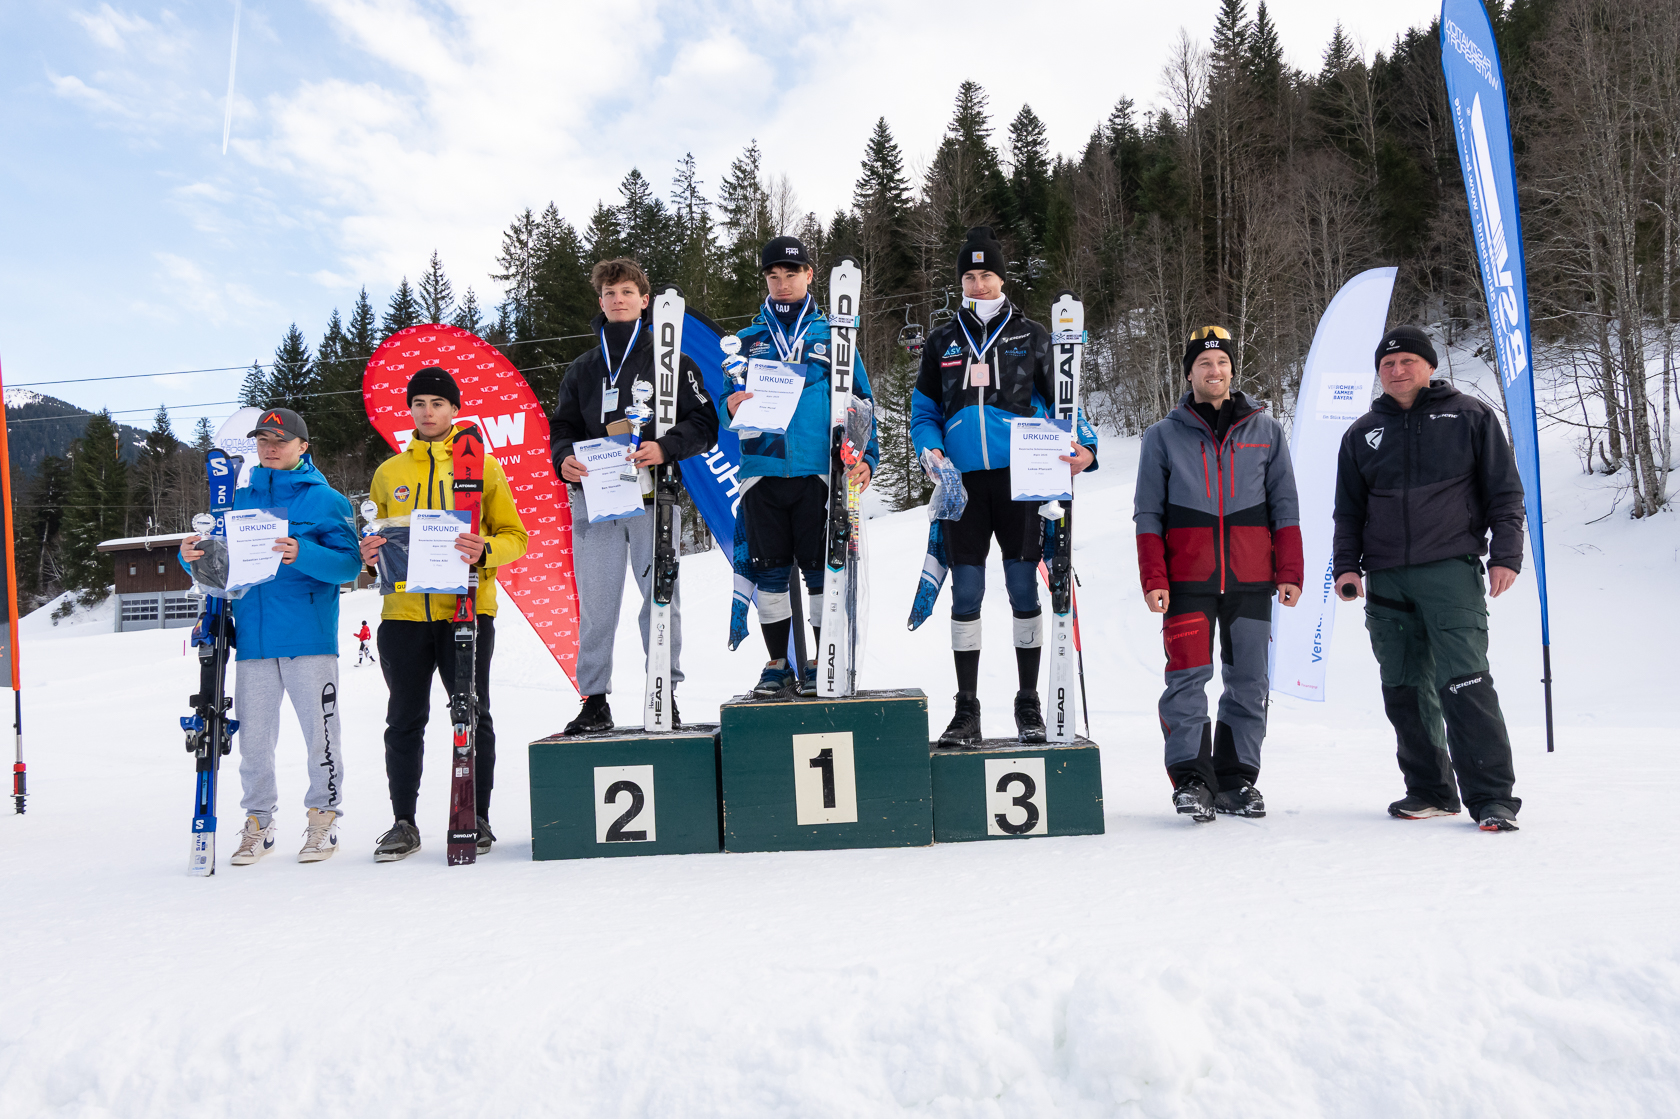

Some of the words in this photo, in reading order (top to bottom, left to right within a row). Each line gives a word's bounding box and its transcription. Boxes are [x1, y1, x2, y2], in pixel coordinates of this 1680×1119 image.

[1205, 341, 1220, 349] SGZ
[660, 322, 675, 424] HEAD
[759, 375, 794, 384] URKUNDE
[587, 450, 622, 462] URKUNDE
[239, 524, 277, 532] URKUNDE
[1172, 629, 1199, 640] ziener
[827, 644, 835, 692] HEAD
[320, 682, 338, 806] Champion
[809, 748, 835, 808] 1
[604, 780, 647, 841] 2
[994, 772, 1038, 834] 3
